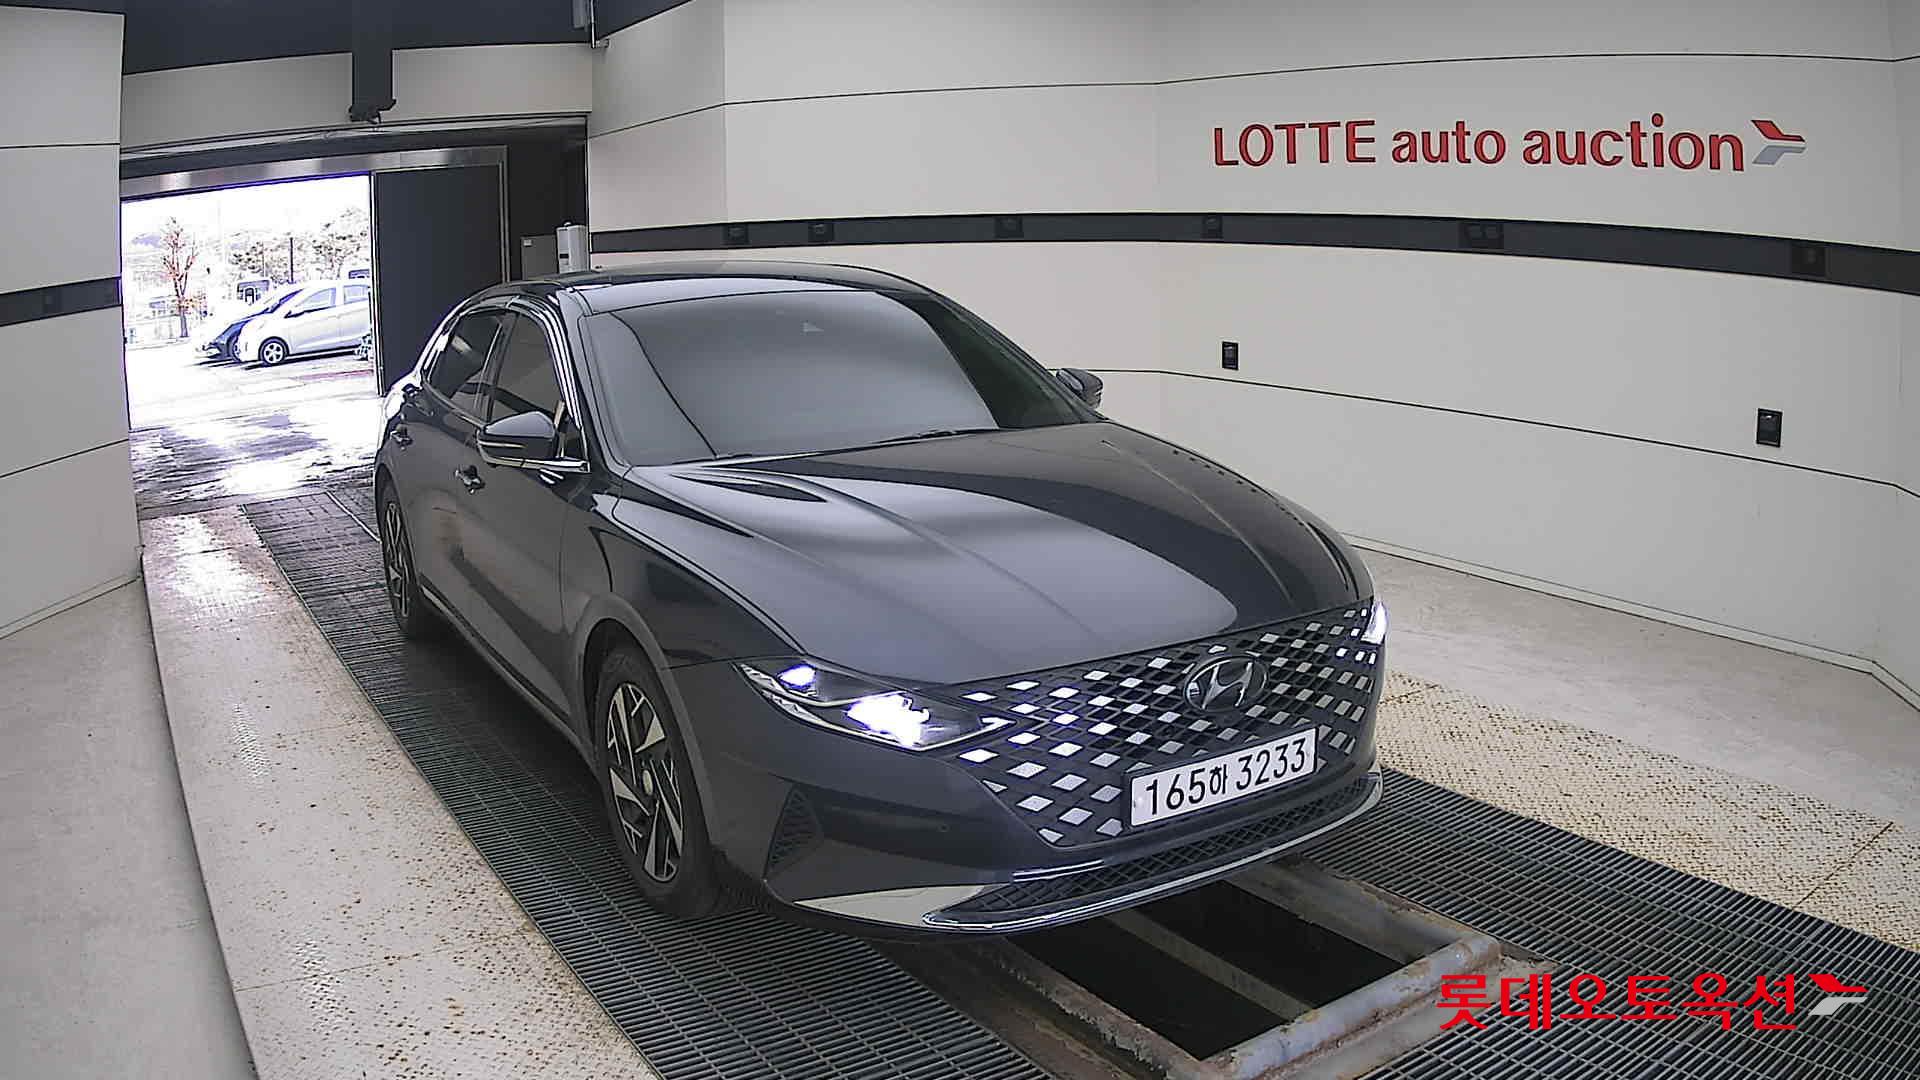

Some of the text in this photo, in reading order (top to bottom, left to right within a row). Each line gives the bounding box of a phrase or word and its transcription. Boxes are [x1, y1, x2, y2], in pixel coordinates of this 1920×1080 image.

[1213, 112, 1746, 172] LOTTE auto auction
[1145, 737, 1307, 816] 165하 3233
